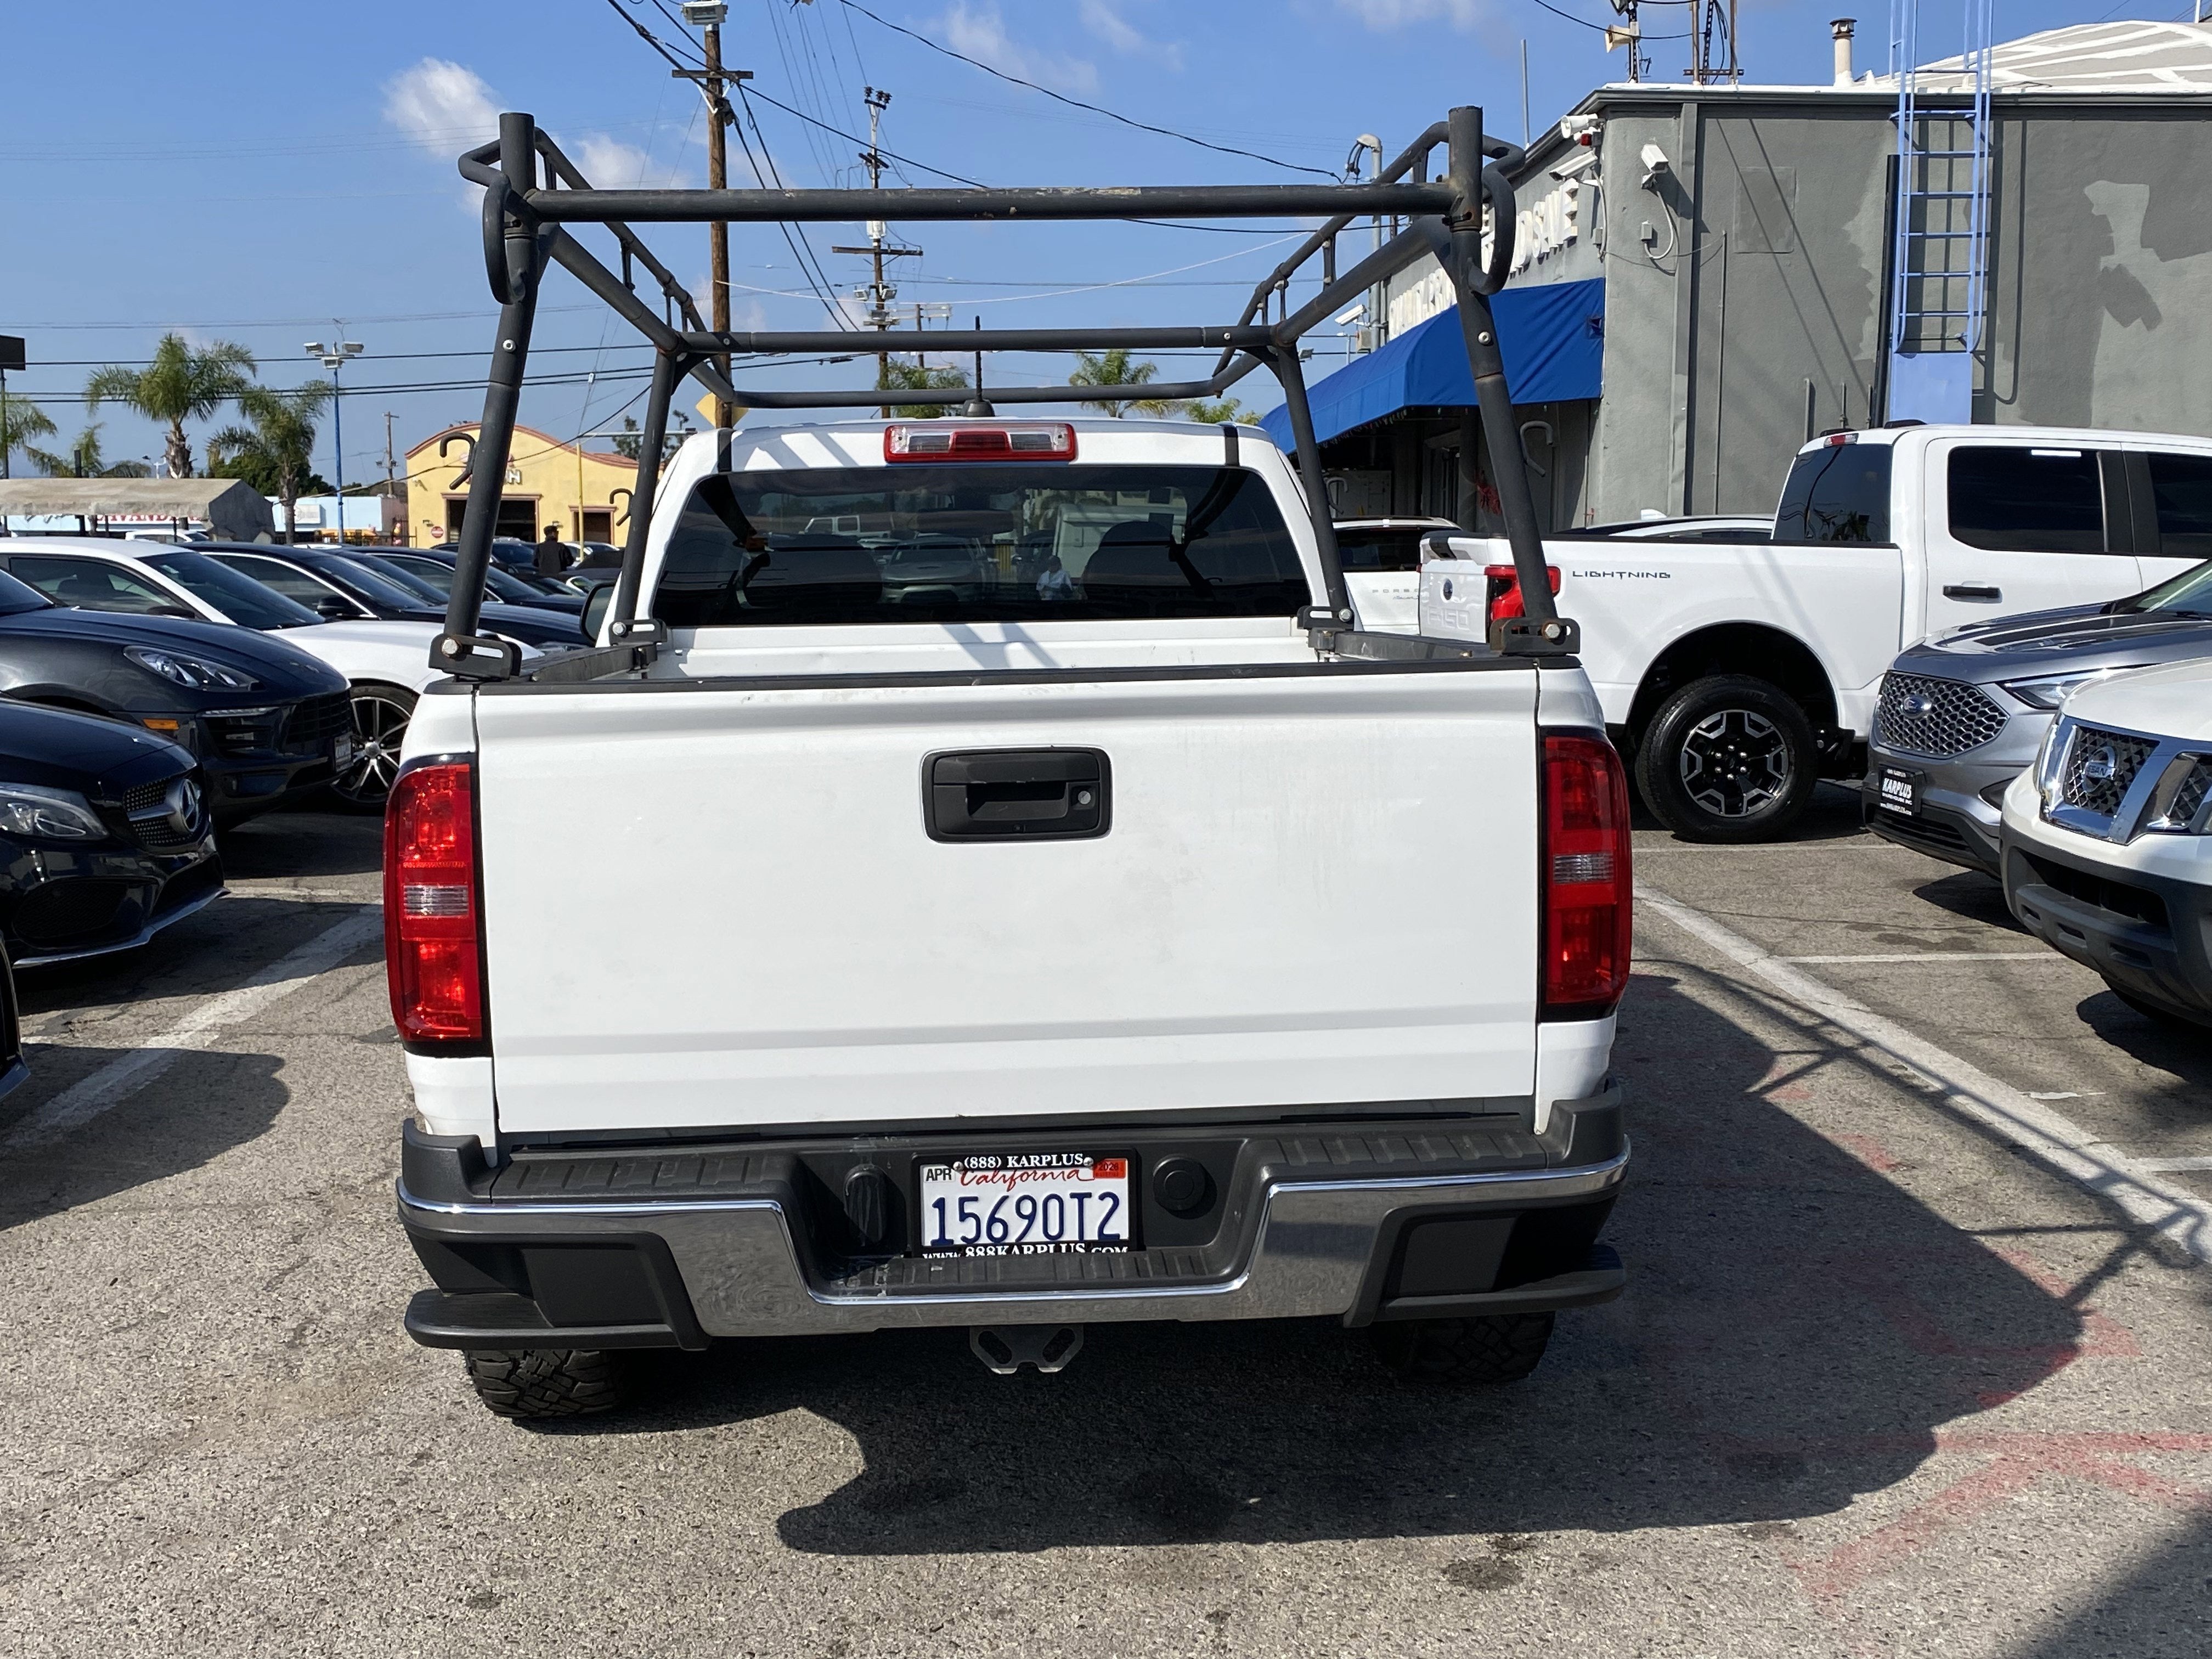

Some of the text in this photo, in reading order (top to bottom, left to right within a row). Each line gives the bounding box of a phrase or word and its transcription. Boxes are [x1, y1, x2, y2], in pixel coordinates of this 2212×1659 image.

[1572, 571, 1671, 579] LIGHTNING
[1882, 778, 1912, 798] KARPLUS
[964, 1153, 1083, 1169] (888) KARPLUS
[926, 1167, 952, 1181] APR
[960, 1168, 1095, 1192] California
[930, 1192, 1120, 1245] 15690T2
